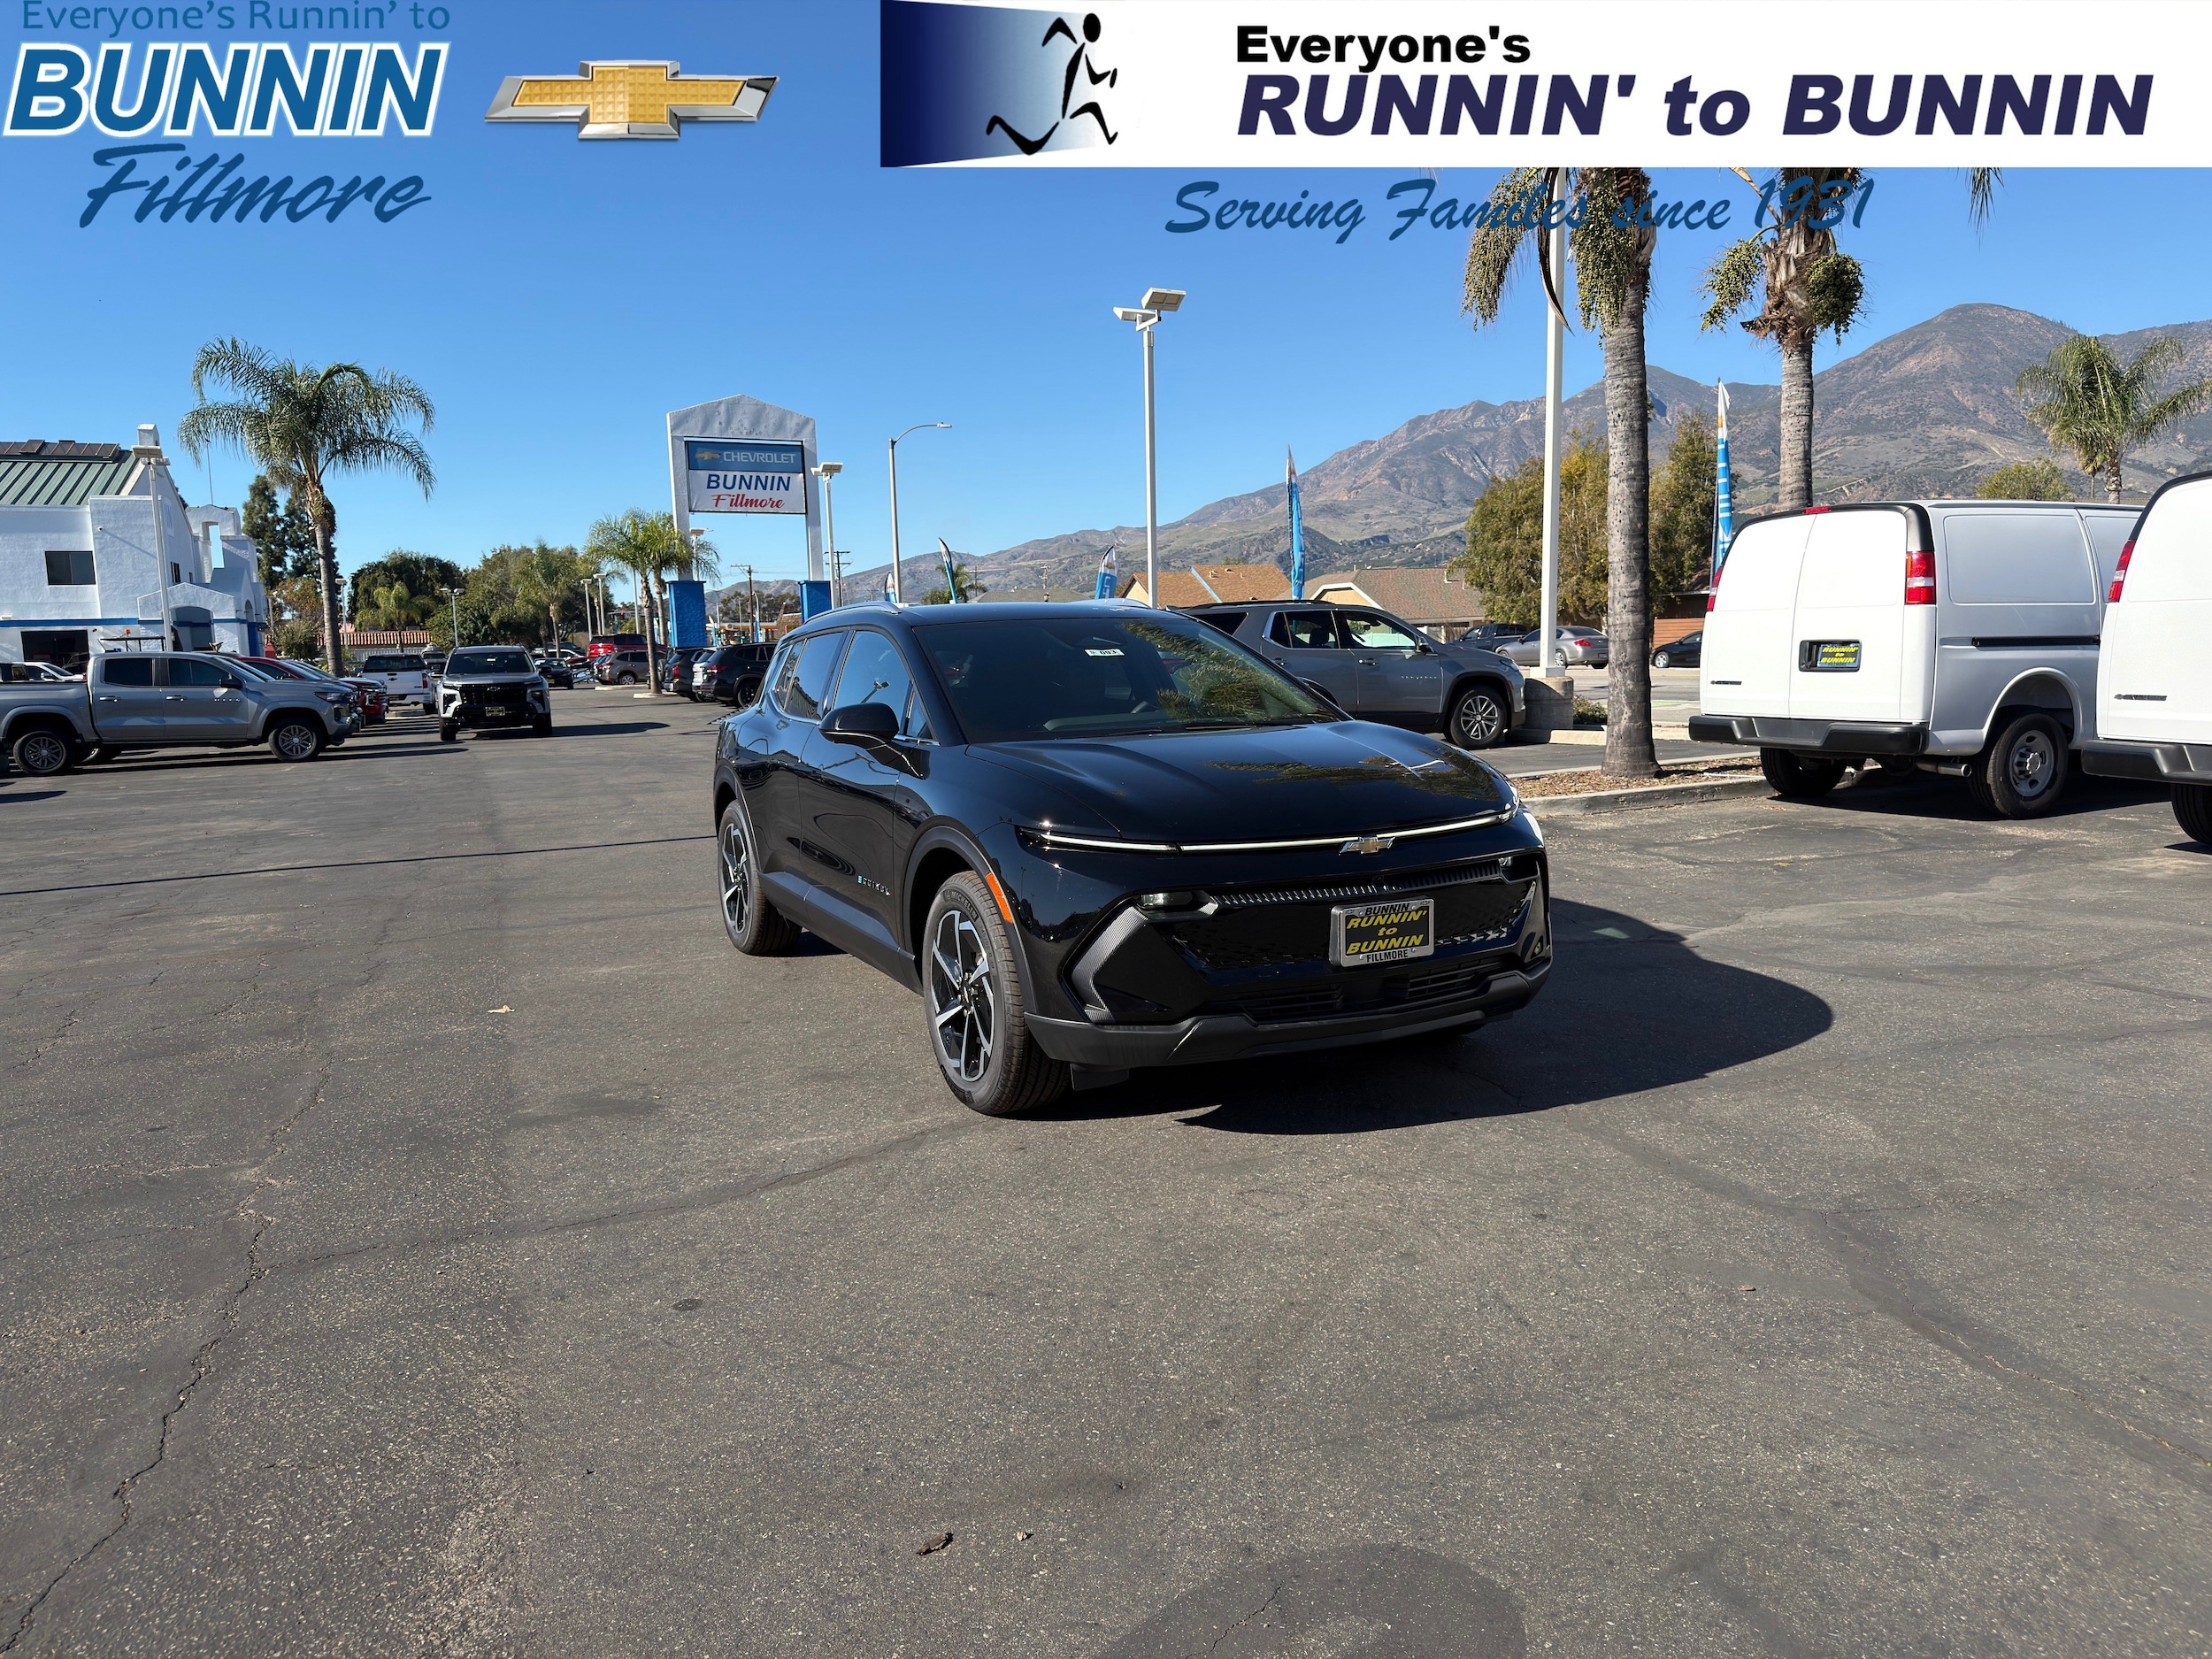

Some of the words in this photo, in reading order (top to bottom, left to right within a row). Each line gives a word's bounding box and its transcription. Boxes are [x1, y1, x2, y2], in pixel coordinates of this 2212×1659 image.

[723, 451, 795, 464] CHEVROLET
[706, 473, 791, 491] BUNNIN
[710, 494, 786, 509] Fillmore
[951, 889, 979, 920] MICHELIN
[1364, 902, 1410, 916] BUNNIN
[1346, 910, 1428, 929] RUNNIN'
[1378, 926, 1398, 936] to
[1346, 933, 1425, 955] BUNNIN
[1366, 949, 1409, 963] FILLMORE
